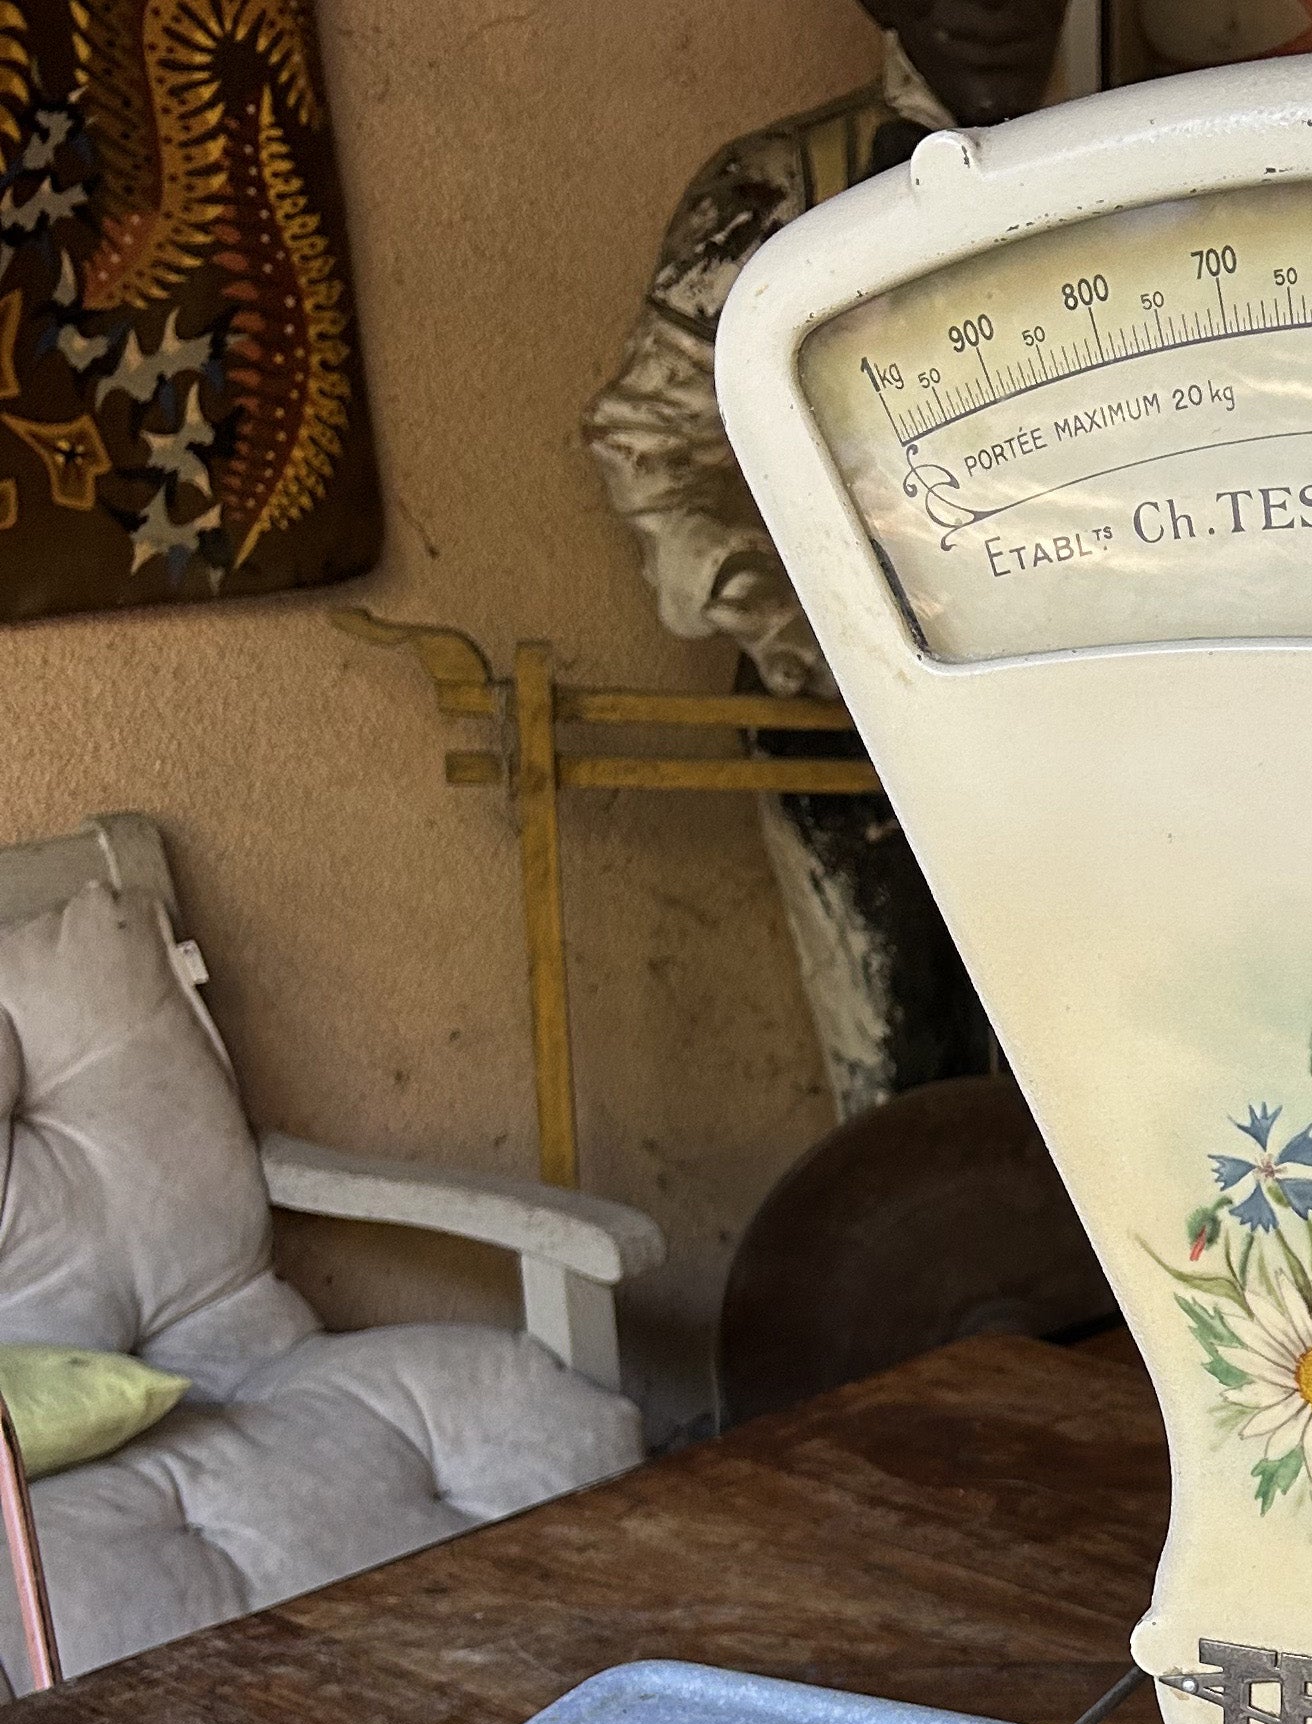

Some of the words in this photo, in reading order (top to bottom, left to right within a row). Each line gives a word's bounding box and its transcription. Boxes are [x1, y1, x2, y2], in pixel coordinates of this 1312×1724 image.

[860, 356, 904, 392] 1kg
[918, 368, 941, 388] 50
[948, 314, 994, 352] 900
[1022, 326, 1046, 346] 50
[1062, 274, 1109, 311] 800
[1140, 291, 1164, 309] 50
[1190, 245, 1237, 279] 700
[1273, 267, 1298, 286] 50
[965, 427, 1048, 476] PORTÉE
[1054, 392, 1161, 442] MAXIMUM
